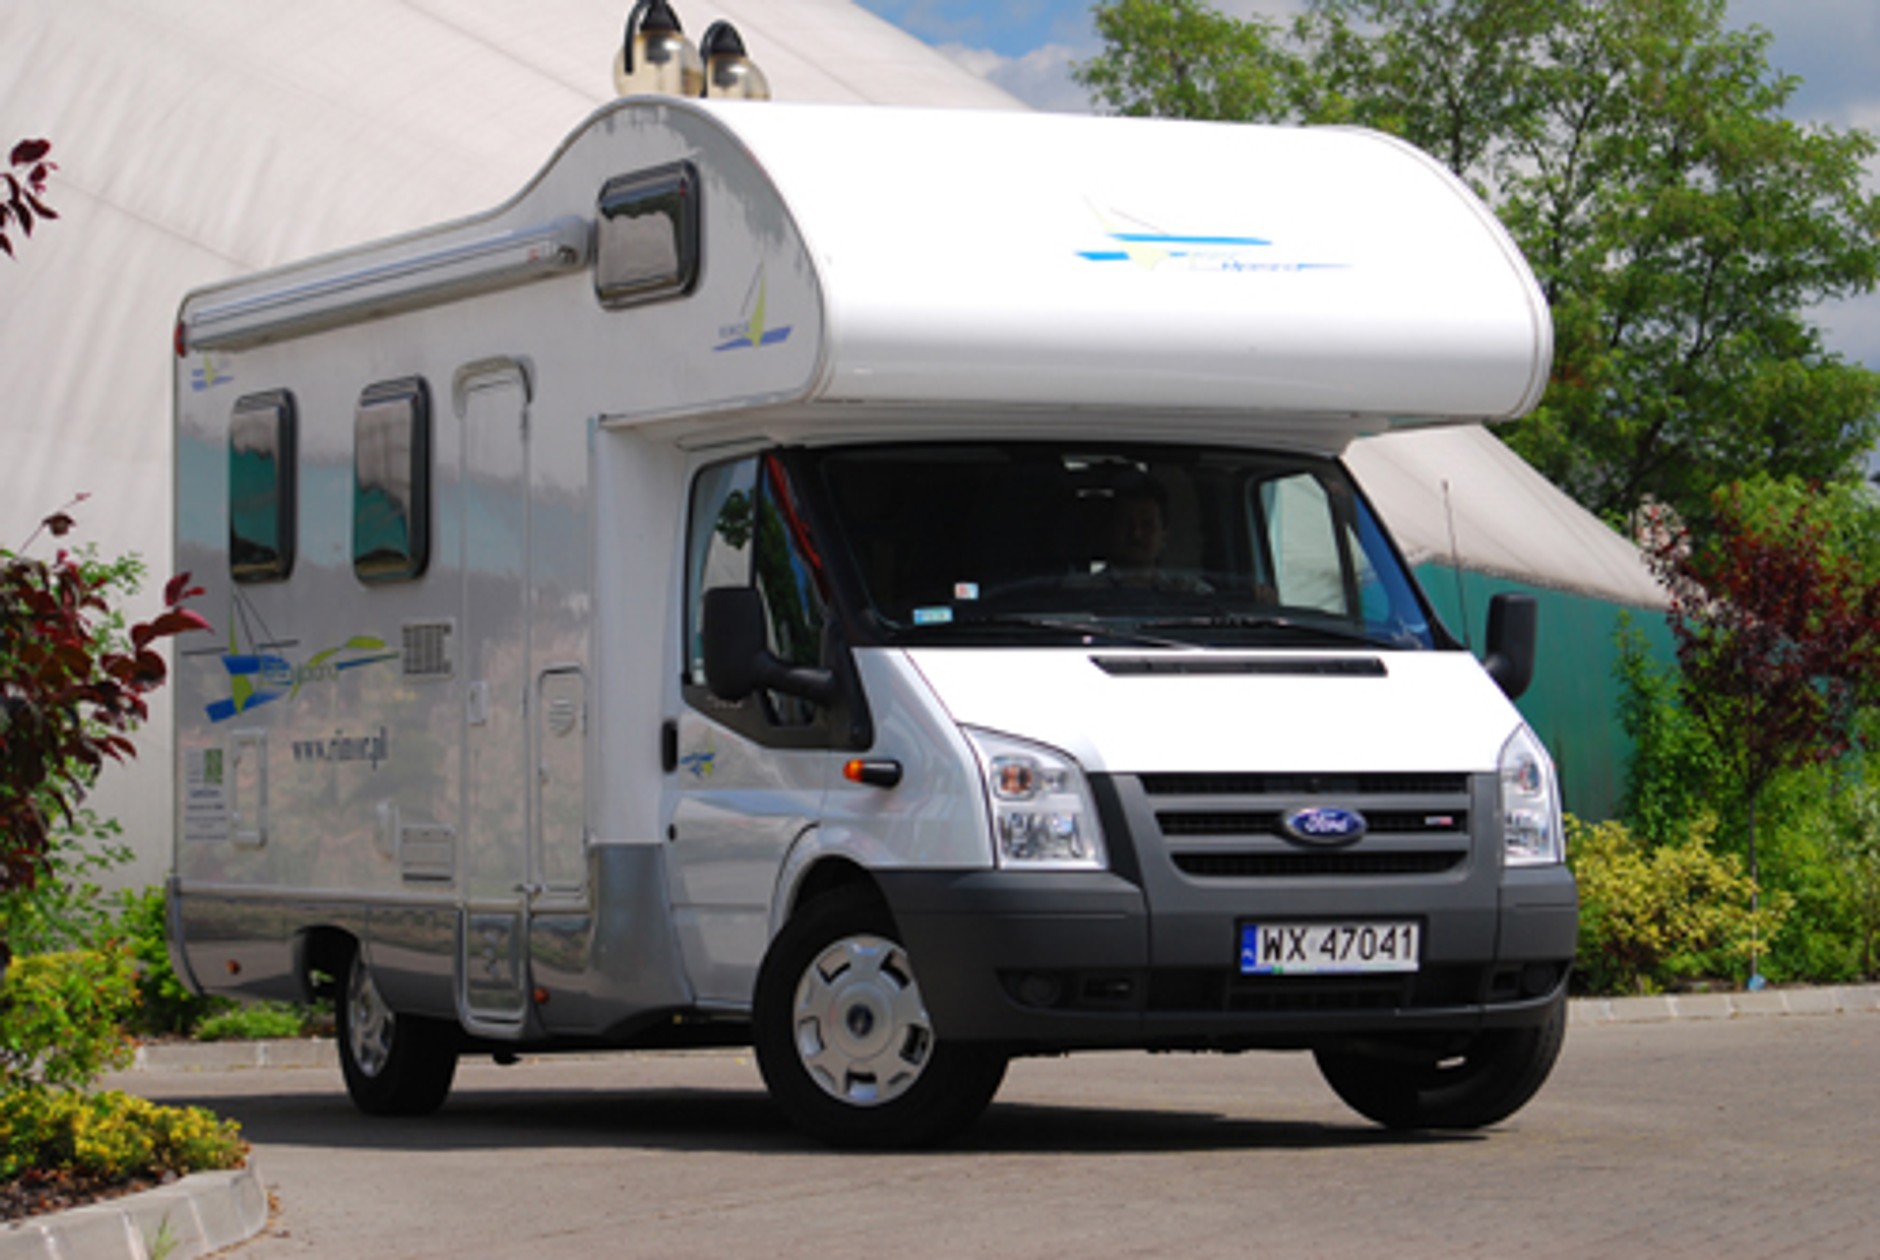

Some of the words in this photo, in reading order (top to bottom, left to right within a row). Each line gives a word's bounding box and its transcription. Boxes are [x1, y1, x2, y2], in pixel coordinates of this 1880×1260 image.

[1303, 812, 1348, 833] Ford
[1263, 927, 1308, 962] WX
[1319, 924, 1412, 961] 47041
